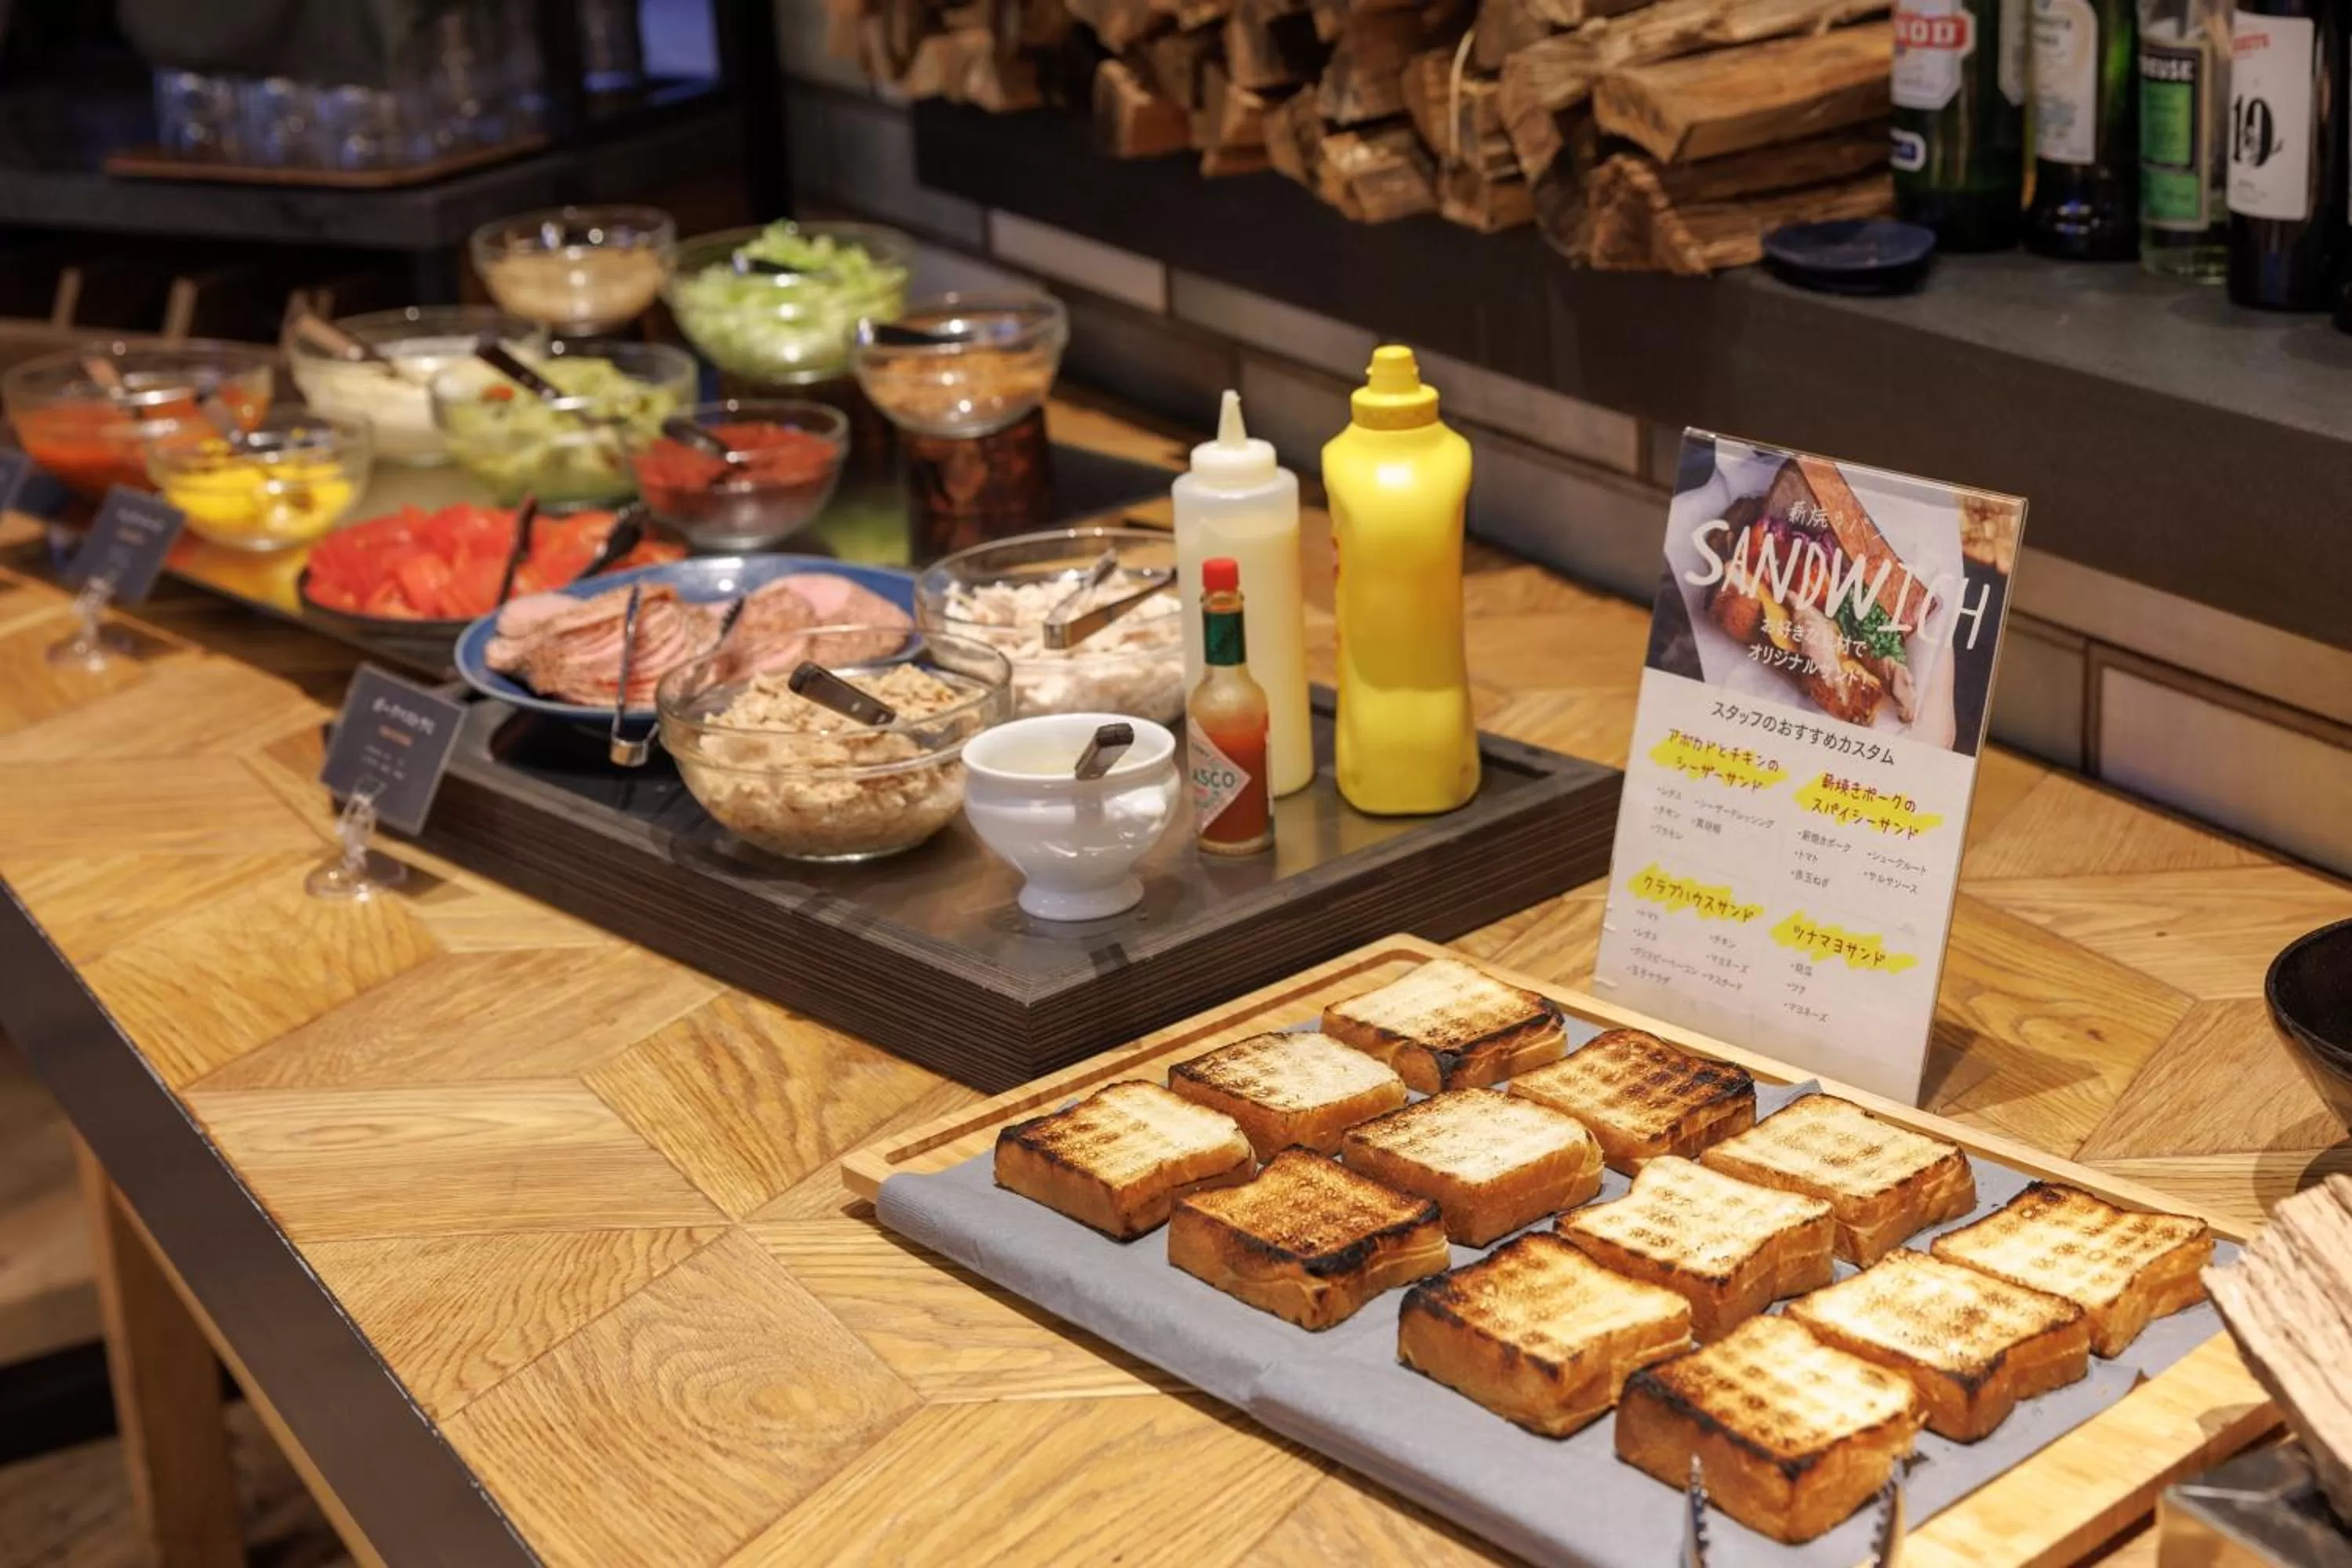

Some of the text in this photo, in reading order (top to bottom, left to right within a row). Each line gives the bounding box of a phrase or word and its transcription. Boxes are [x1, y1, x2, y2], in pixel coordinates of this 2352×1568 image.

[1685, 519, 1991, 650] SANDWICH
[1668, 728, 1779, 772] アボカドとチキンの
[1711, 701, 1895, 766] スタッフのおすすめカスタム
[1677, 756, 1763, 793] シーザーサンド
[1821, 772, 1916, 813] 薪焼きポークの
[1812, 797, 1919, 840] スパイシーサンド
[1644, 875, 1754, 923] クラブハウスサンド
[1793, 924, 1886, 967] ツナマヨサンド
